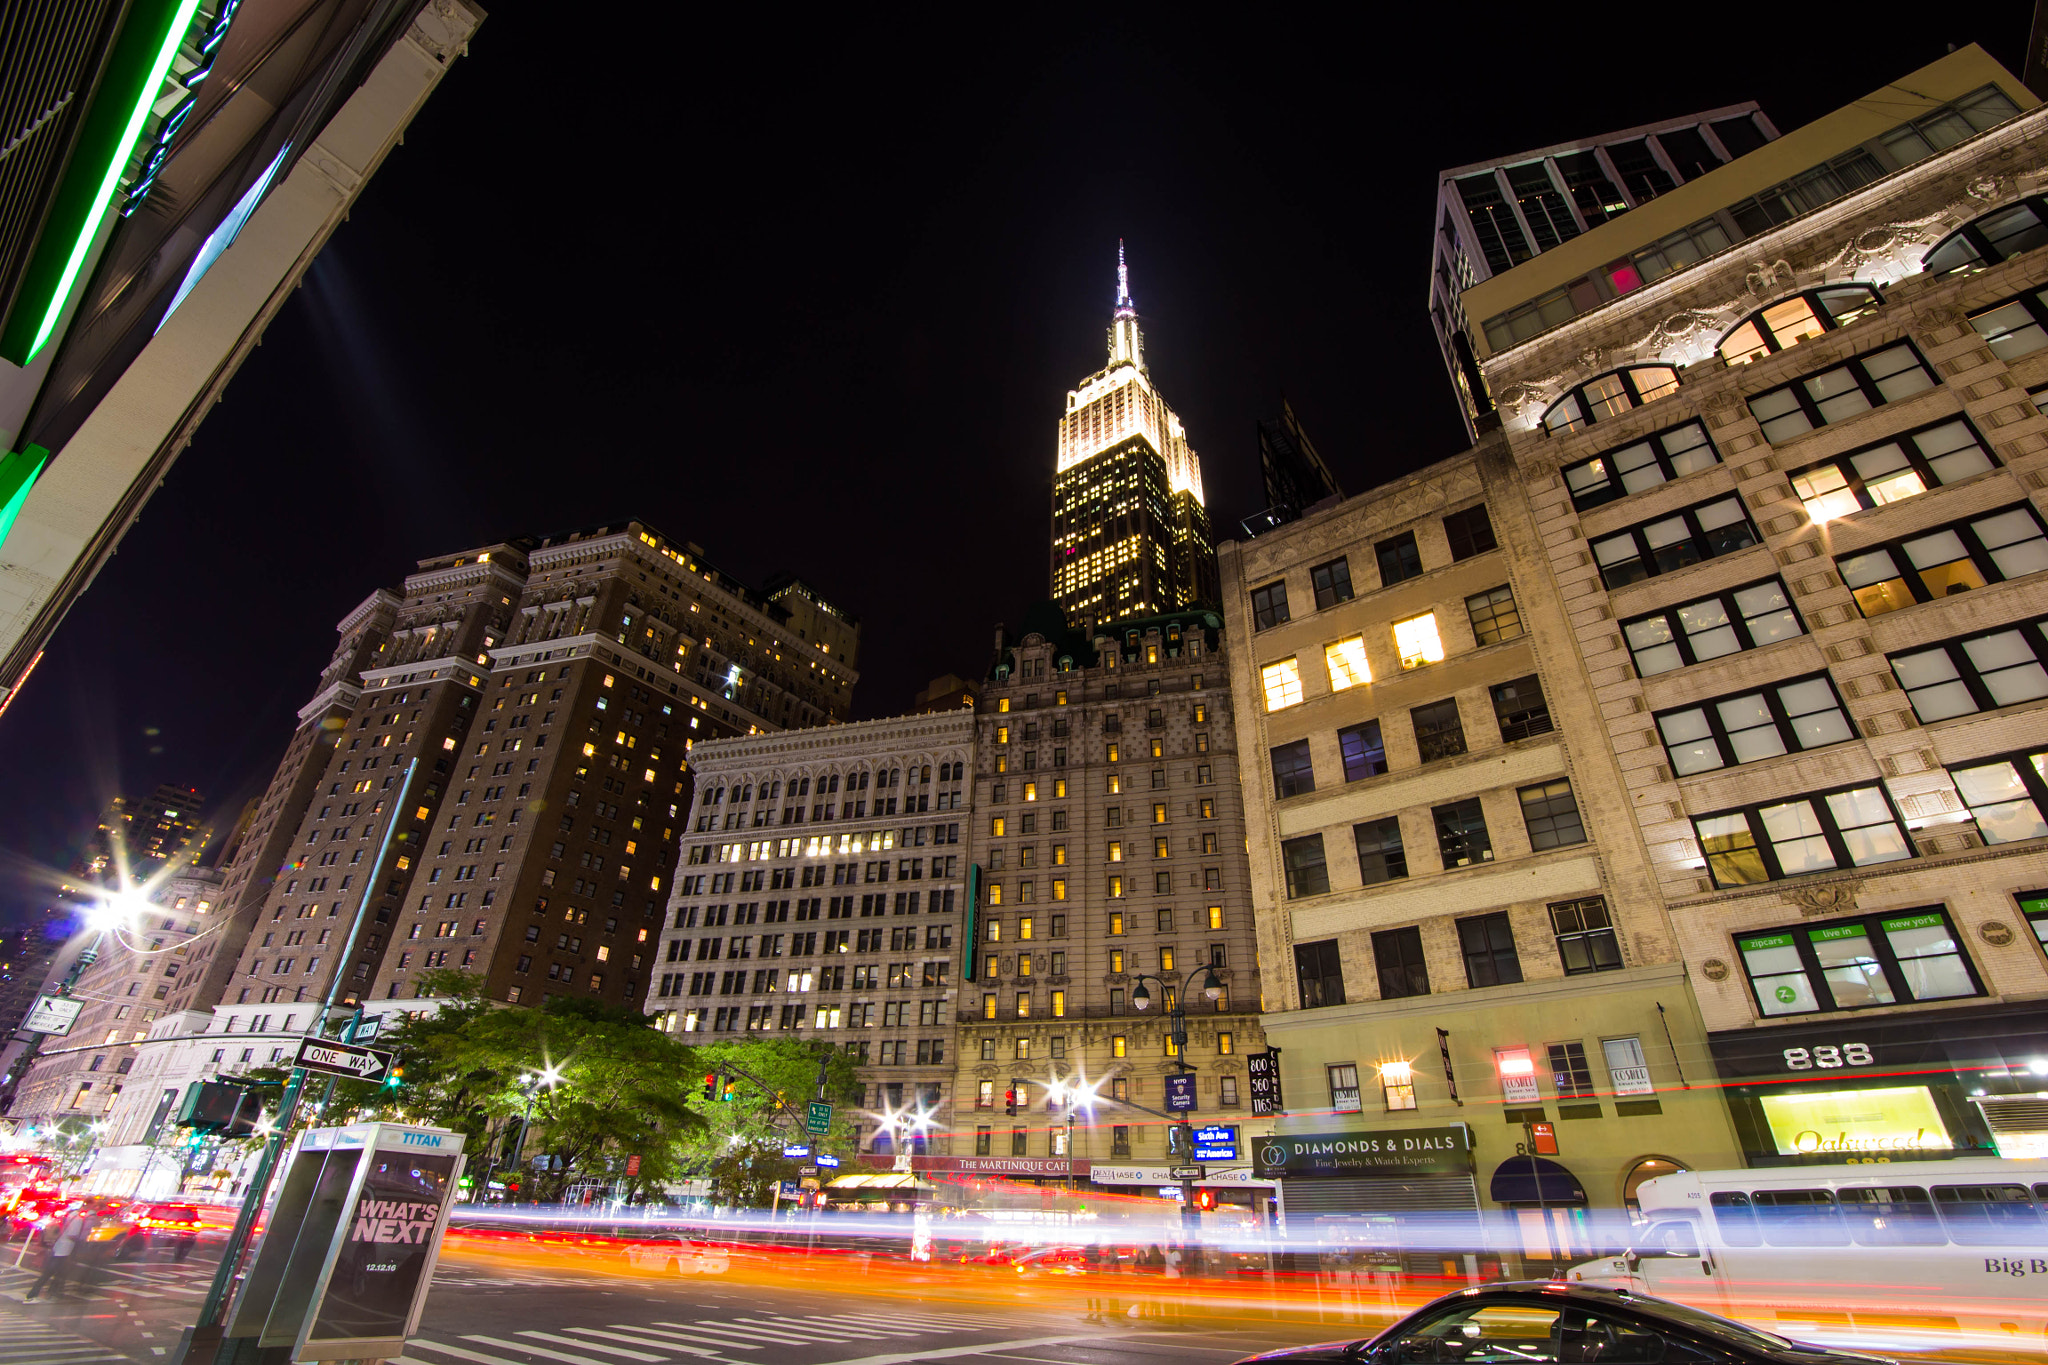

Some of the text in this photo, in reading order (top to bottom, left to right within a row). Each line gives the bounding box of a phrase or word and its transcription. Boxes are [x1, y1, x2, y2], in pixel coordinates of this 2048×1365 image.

[1889, 915, 1936, 929] new york
[1822, 927, 1852, 938] live in
[1750, 936, 1784, 949] zipcars
[312, 1048, 376, 1070] ONE WAY
[1783, 1042, 1874, 1070] 888
[1251, 1058, 1268, 1072] 800
[1252, 1078, 1269, 1092] 560
[1253, 1098, 1272, 1112] 1165
[402, 1132, 442, 1148] TITAN
[1198, 1131, 1228, 1140] Sixth Ave
[1206, 1149, 1233, 1158] Americas
[1294, 1137, 1455, 1156] DIAMONDS & DIALS
[979, 1160, 1043, 1172] MARTINIQUE
[1315, 1155, 1436, 1168] Fine Jewelry & Watch Experts
[360, 1200, 439, 1222] WHAT'S
[352, 1218, 434, 1244] NEXT
[366, 1264, 397, 1272] 12.12.16
[1984, 1257, 2025, 1277] Big
